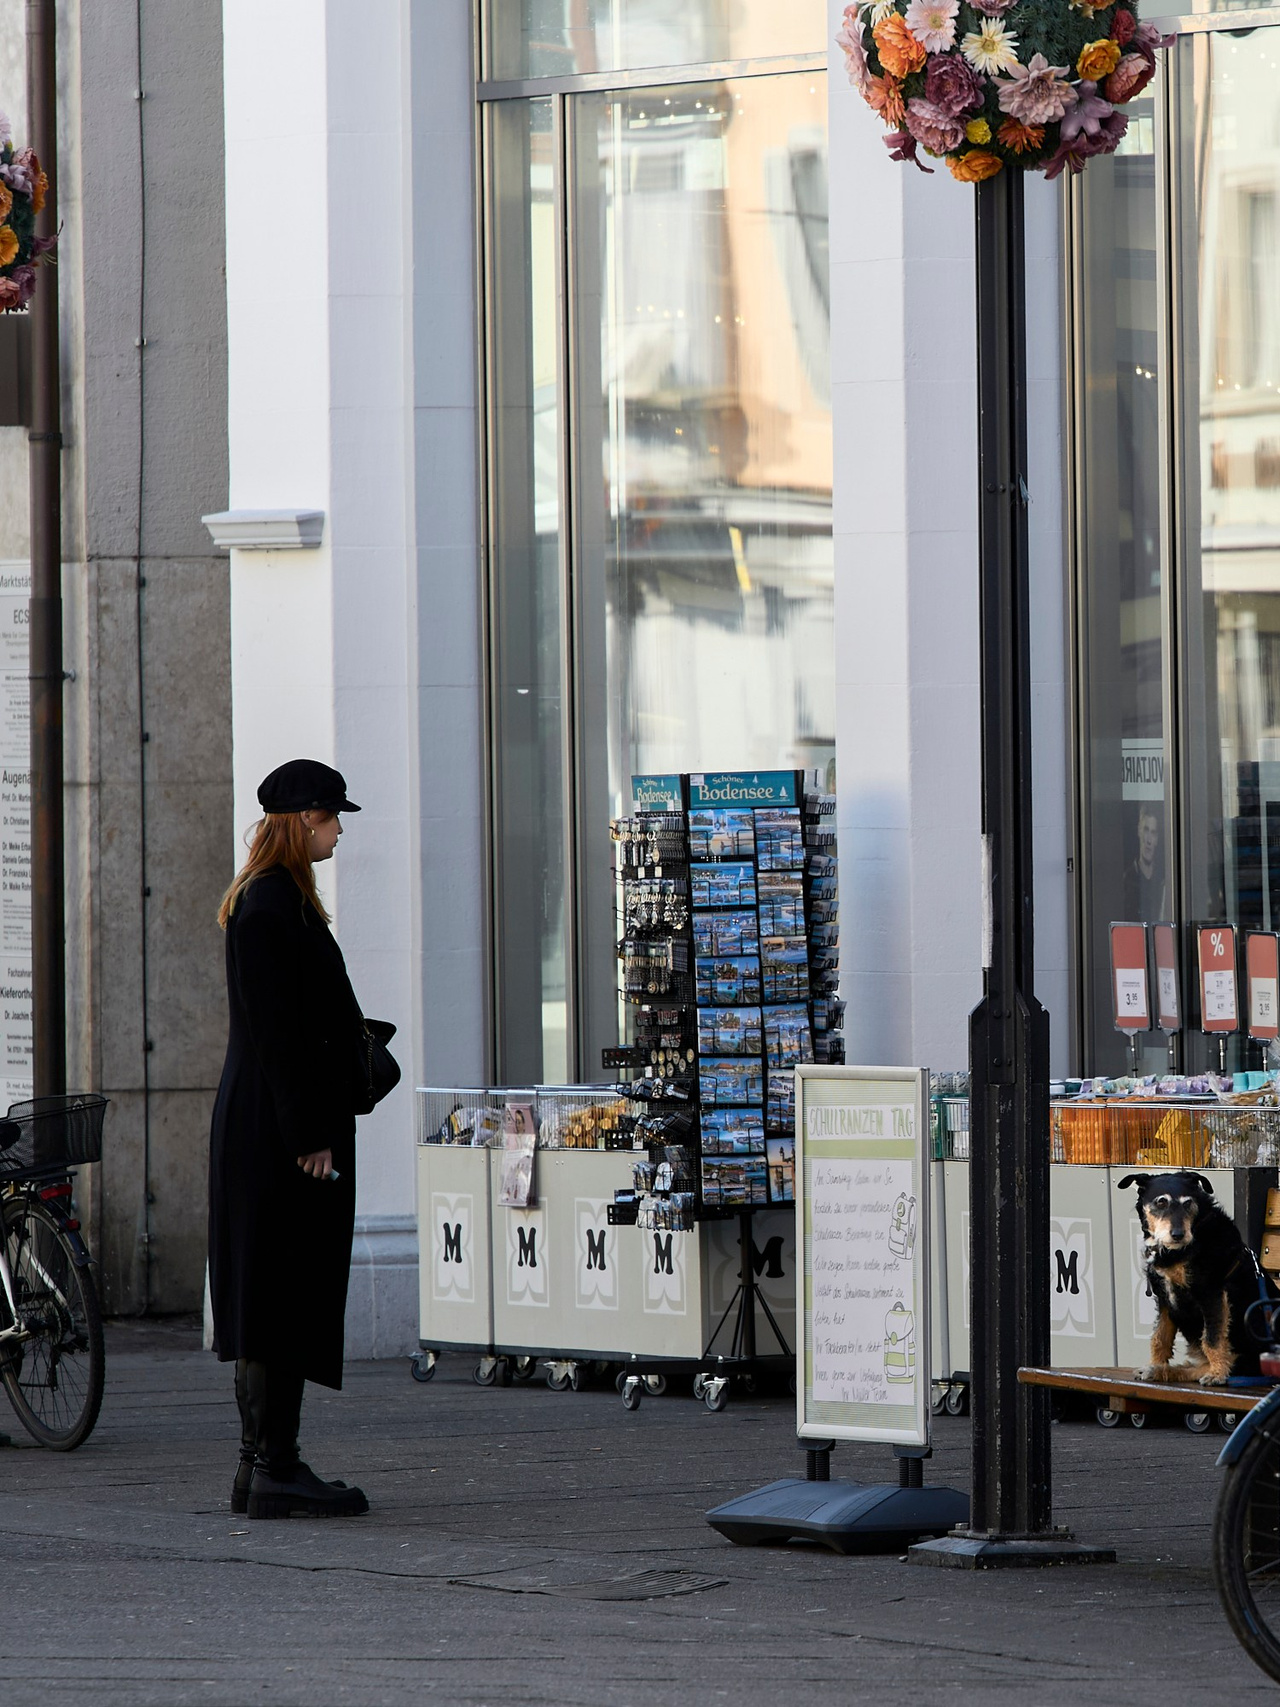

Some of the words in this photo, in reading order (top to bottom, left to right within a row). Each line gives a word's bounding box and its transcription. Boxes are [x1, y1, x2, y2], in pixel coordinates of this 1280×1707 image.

[698, 785, 775, 801] Bodensee
[711, 775, 745, 784] Schöner
[1210, 931, 1225, 957] %
[809, 1107, 884, 1136] SCHULRANZEN
[890, 1107, 914, 1137] TAG
[442, 1221, 463, 1264] M
[516, 1226, 537, 1268] M
[585, 1228, 606, 1271] M
[653, 1232, 674, 1275] M
[1054, 1249, 1080, 1295] M
